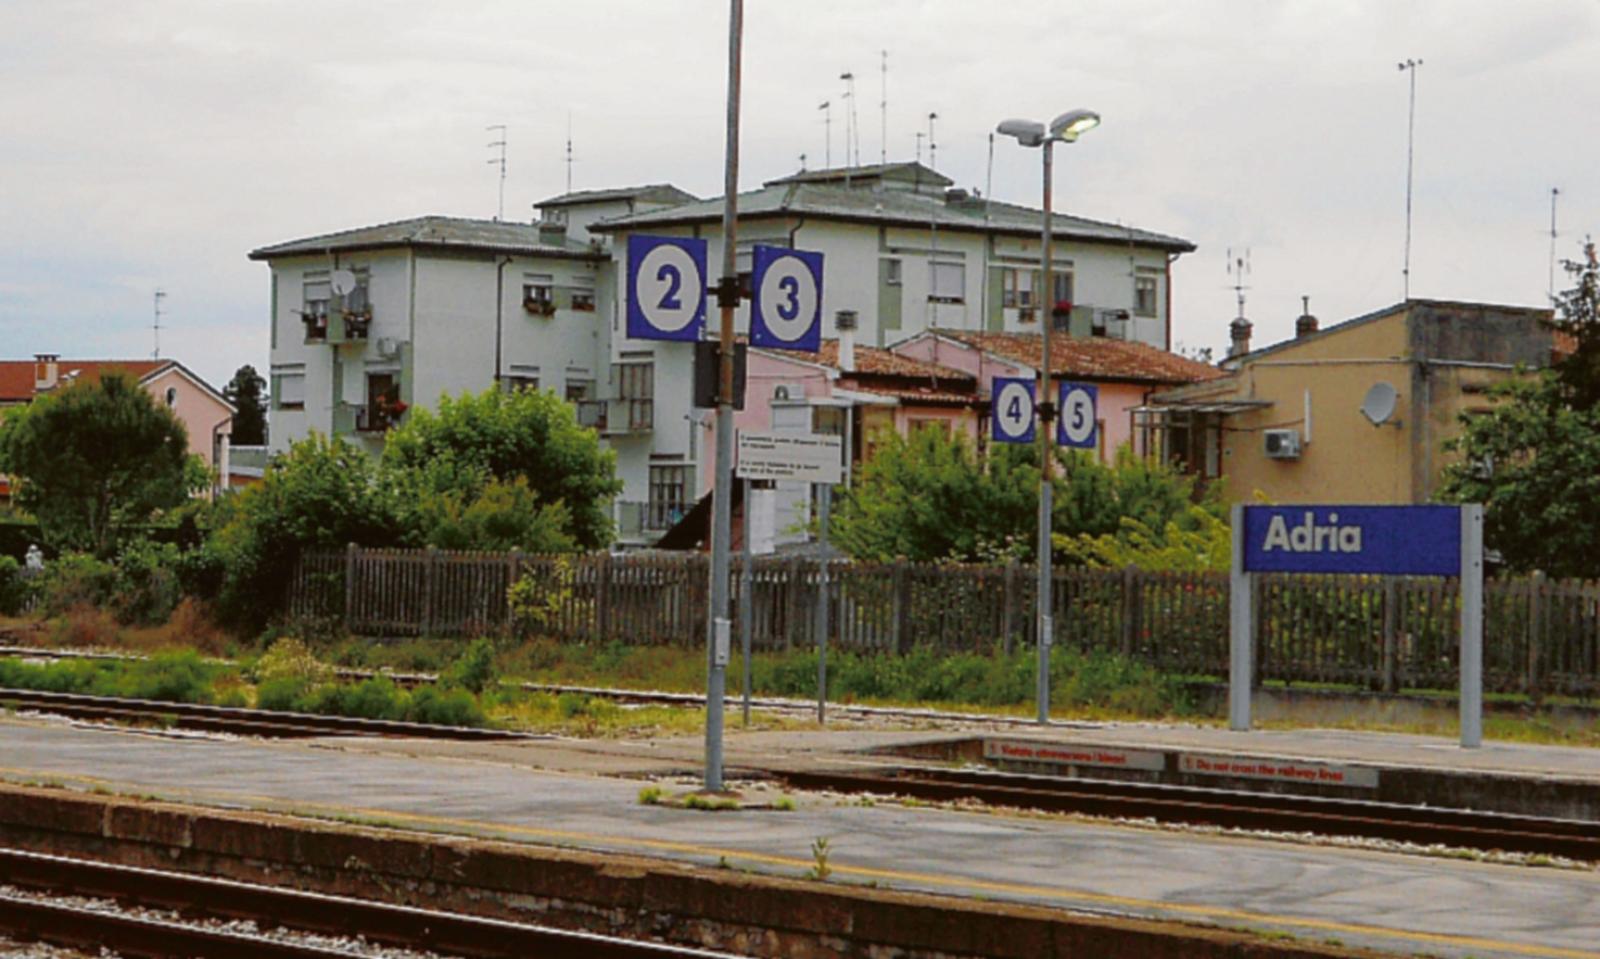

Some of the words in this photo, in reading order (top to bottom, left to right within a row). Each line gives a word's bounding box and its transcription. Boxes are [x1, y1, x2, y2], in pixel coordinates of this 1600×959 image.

[657, 264, 682, 310] 2
[776, 275, 799, 321] 3
[1006, 396, 1022, 424] 4
[1072, 402, 1084, 430] 5
[1262, 511, 1362, 552] Adria
[1196, 758, 1212, 770] Do
[1257, 764, 1275, 776] the
[1277, 765, 1316, 781] railway
